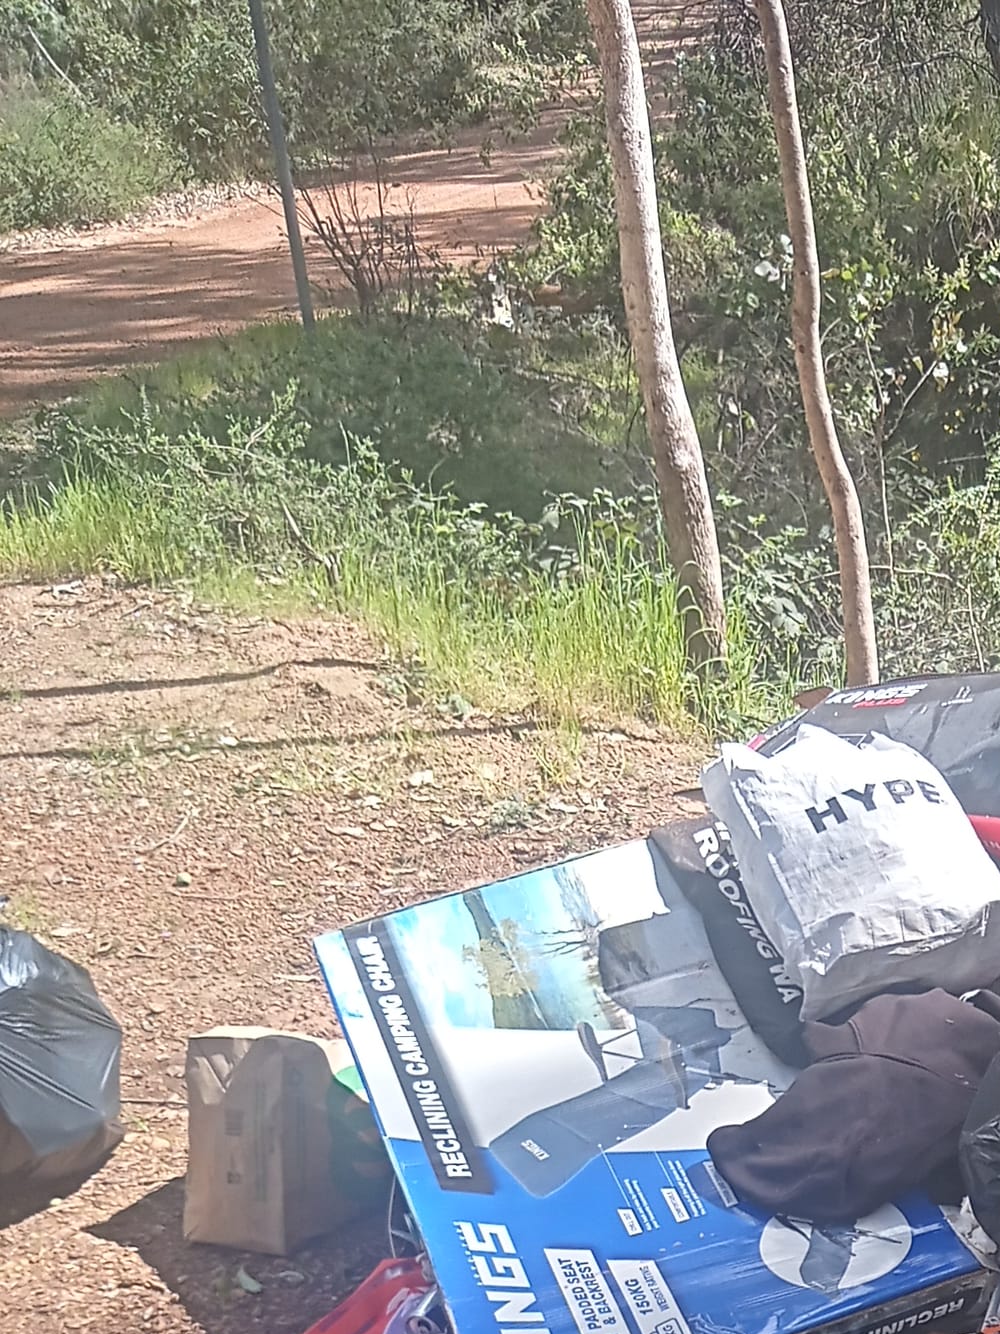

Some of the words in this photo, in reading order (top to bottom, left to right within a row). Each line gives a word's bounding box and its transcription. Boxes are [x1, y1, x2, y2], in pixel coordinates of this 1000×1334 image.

[804, 779, 943, 834] HYPE
[693, 827, 779, 960] ROOFING
[357, 936, 396, 991] CHAIR
[378, 995, 430, 1076] CAMPING
[413, 1080, 472, 1178] RECLINING
[558, 1258, 580, 1285] SEAT
[575, 1260, 612, 1315] BACKREST
[624, 1278, 654, 1316] 150KG
[572, 1286, 602, 1331] PADDED
[603, 1316, 617, 1326] &
